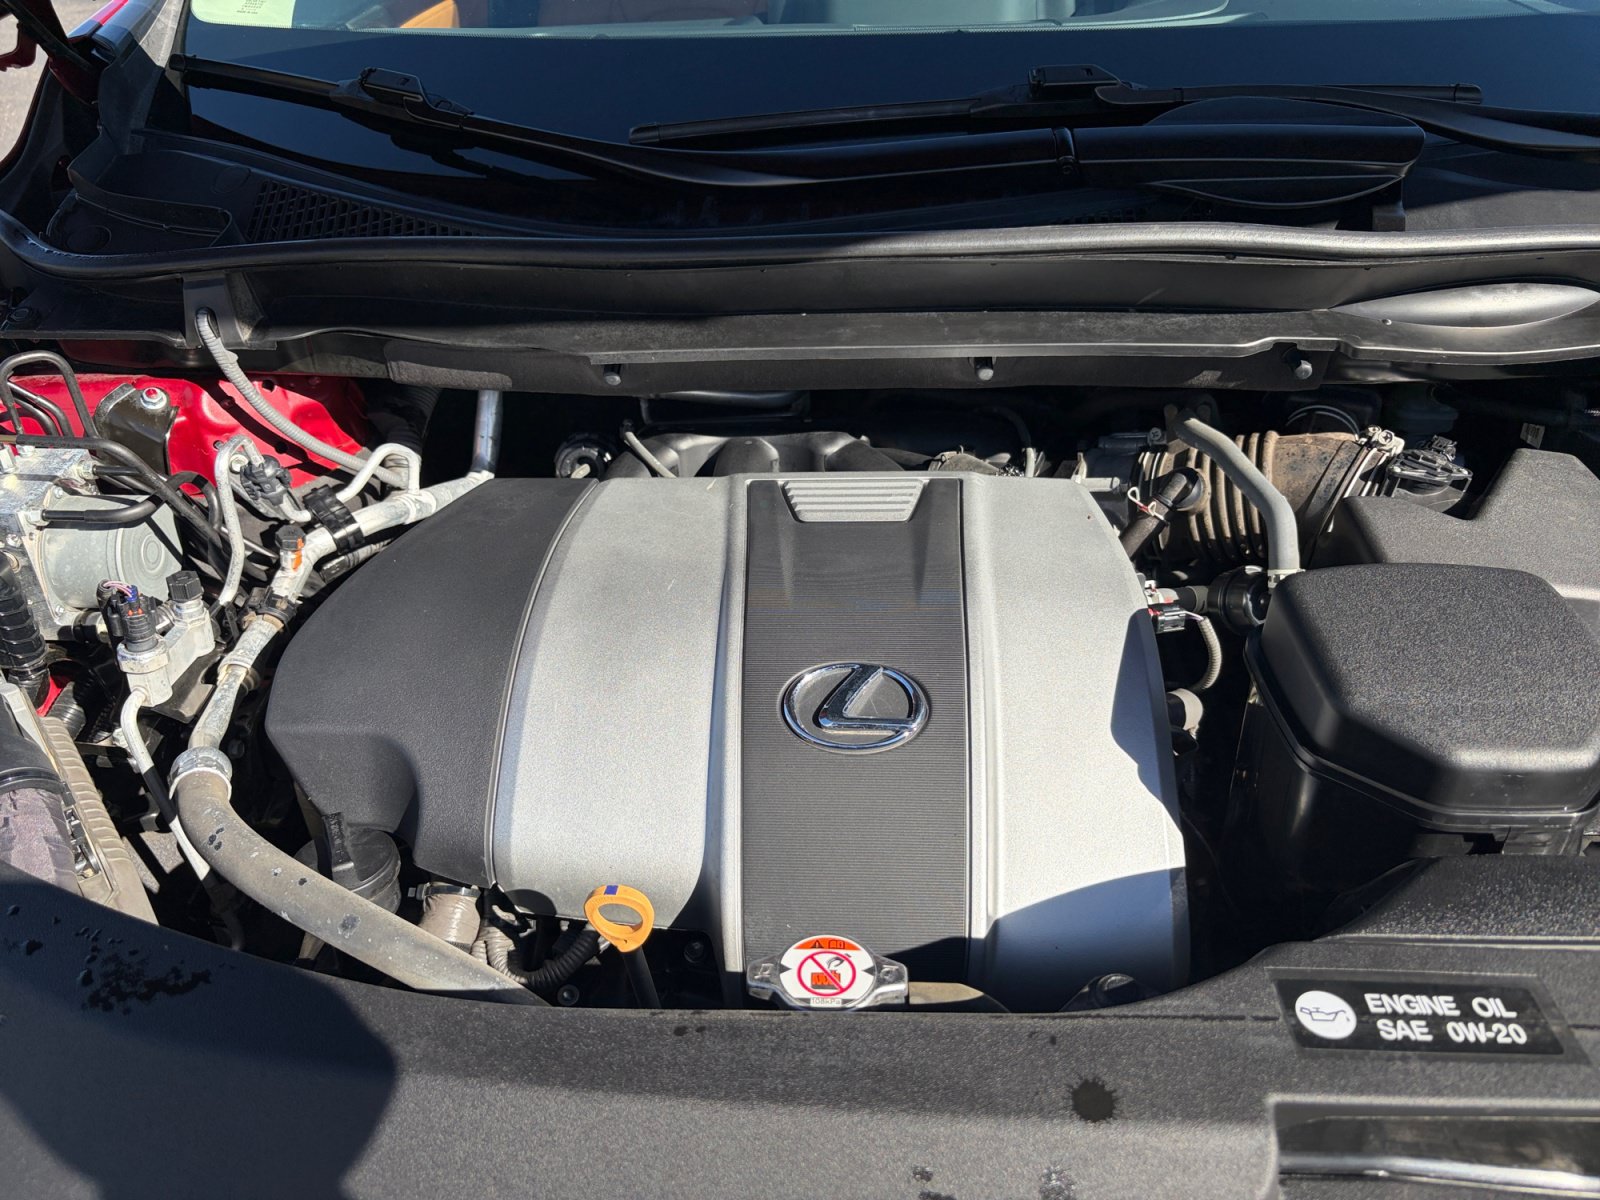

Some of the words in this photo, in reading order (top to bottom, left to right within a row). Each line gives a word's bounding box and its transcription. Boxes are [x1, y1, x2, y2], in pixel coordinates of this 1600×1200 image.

[1364, 993, 1460, 1017] ENGINE
[1472, 997, 1517, 1018] OIL
[1376, 1019, 1433, 1041] SAE
[1446, 1022, 1527, 1045] 0W-20
